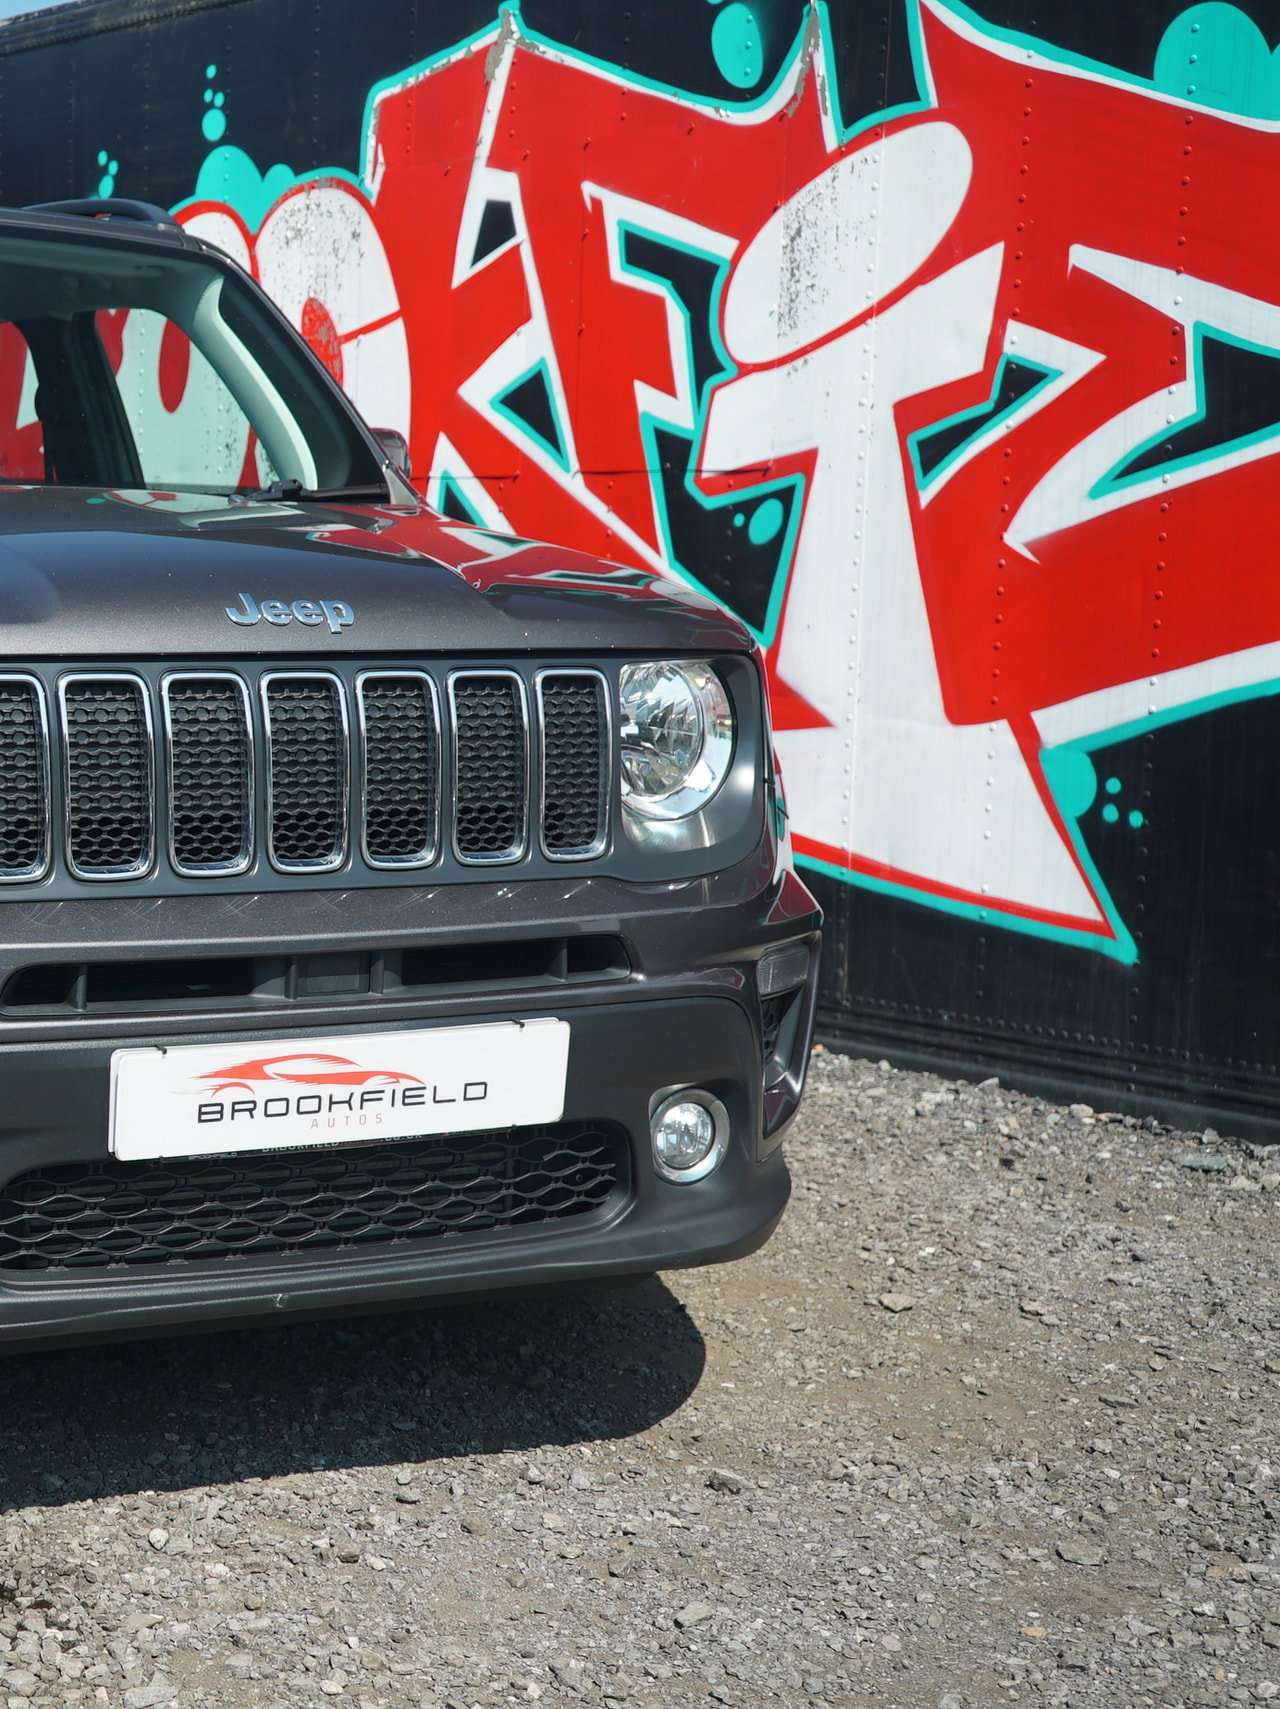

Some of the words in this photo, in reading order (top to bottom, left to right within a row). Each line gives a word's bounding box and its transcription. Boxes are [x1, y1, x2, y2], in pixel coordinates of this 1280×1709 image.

[224, 592, 355, 634] Jeep
[197, 1081, 488, 1123] BROOKFIELD
[310, 1113, 384, 1129] AUTOS
